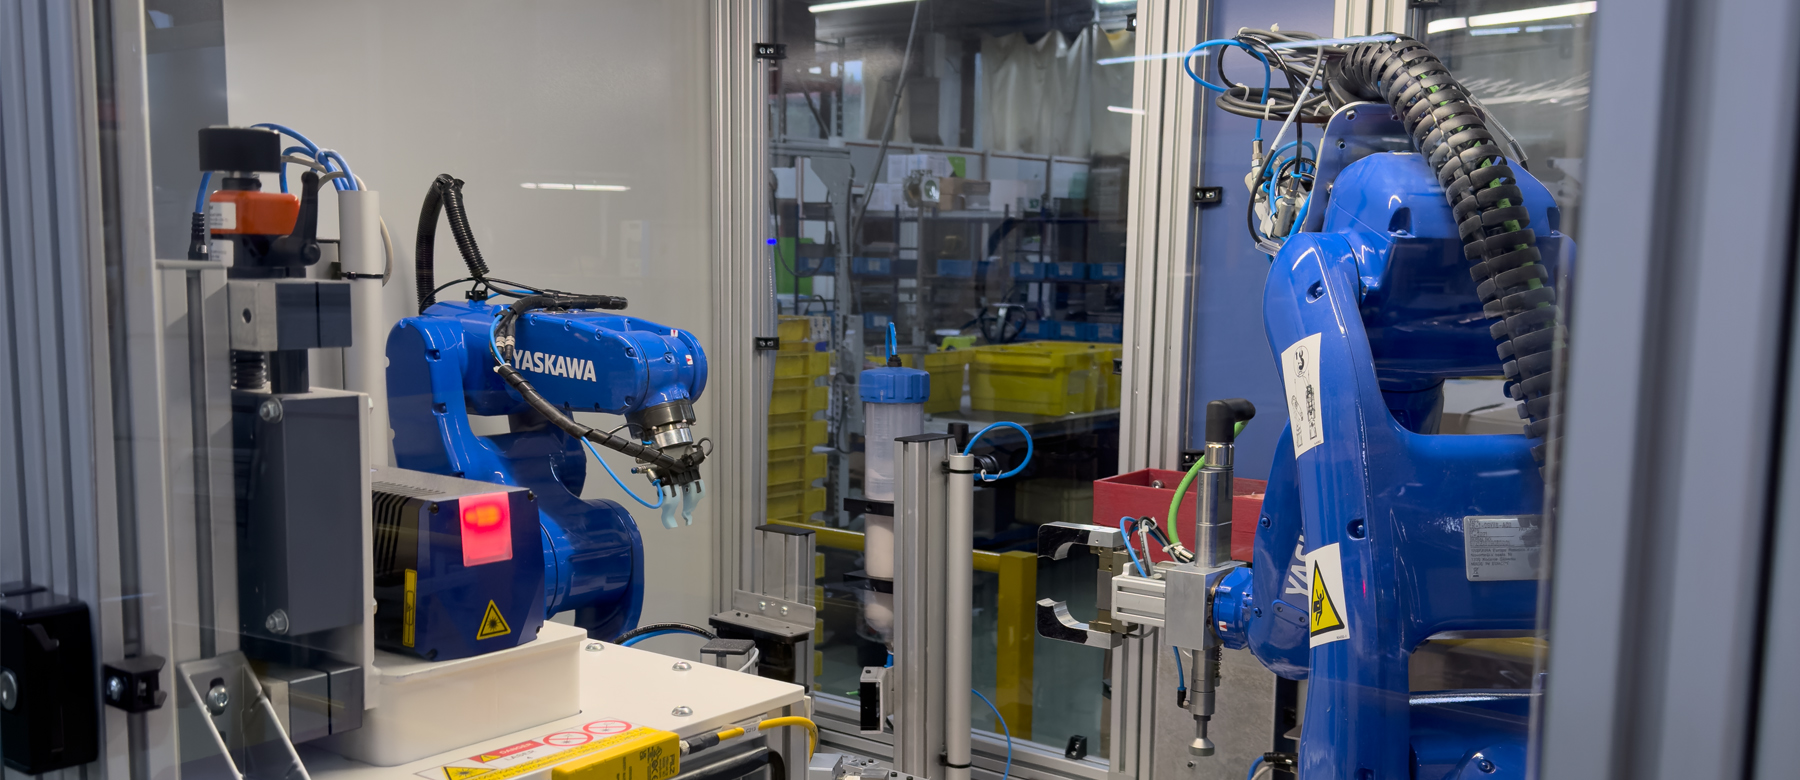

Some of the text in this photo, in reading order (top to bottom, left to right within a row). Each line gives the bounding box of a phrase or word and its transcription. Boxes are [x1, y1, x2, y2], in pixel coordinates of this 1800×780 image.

[513, 349, 597, 382] YASKAWA
[499, 742, 533, 755] DANGER
[504, 749, 535, 761] LASER
